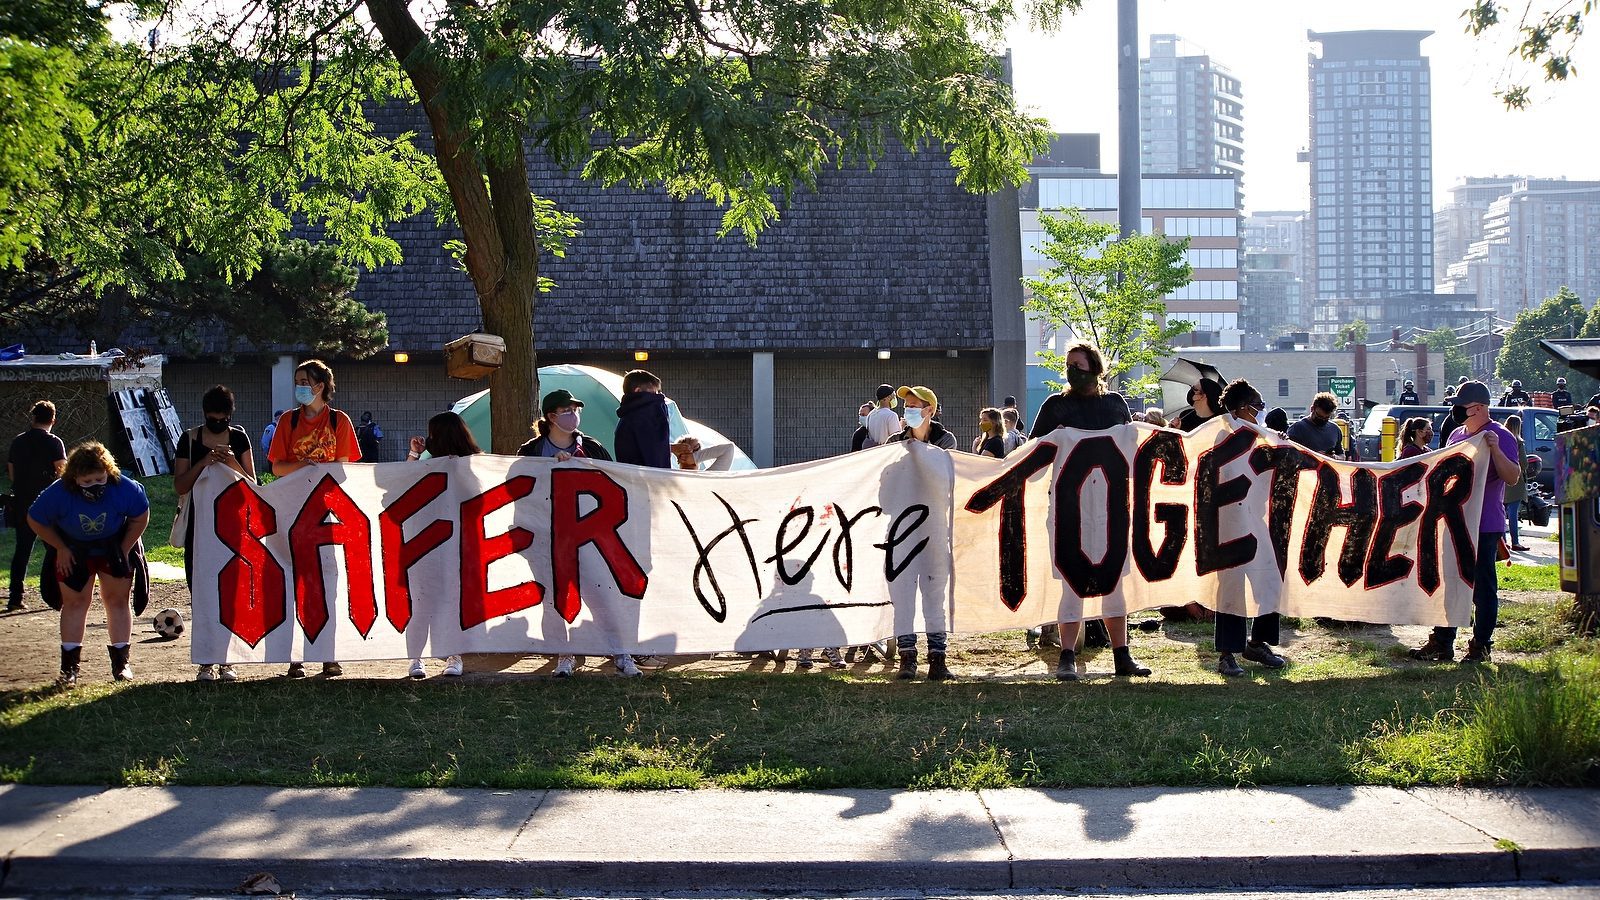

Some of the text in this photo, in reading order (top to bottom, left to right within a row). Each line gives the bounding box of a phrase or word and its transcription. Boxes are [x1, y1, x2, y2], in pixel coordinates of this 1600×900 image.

[213, 426, 1478, 650] SAFER Here TOGETHER
